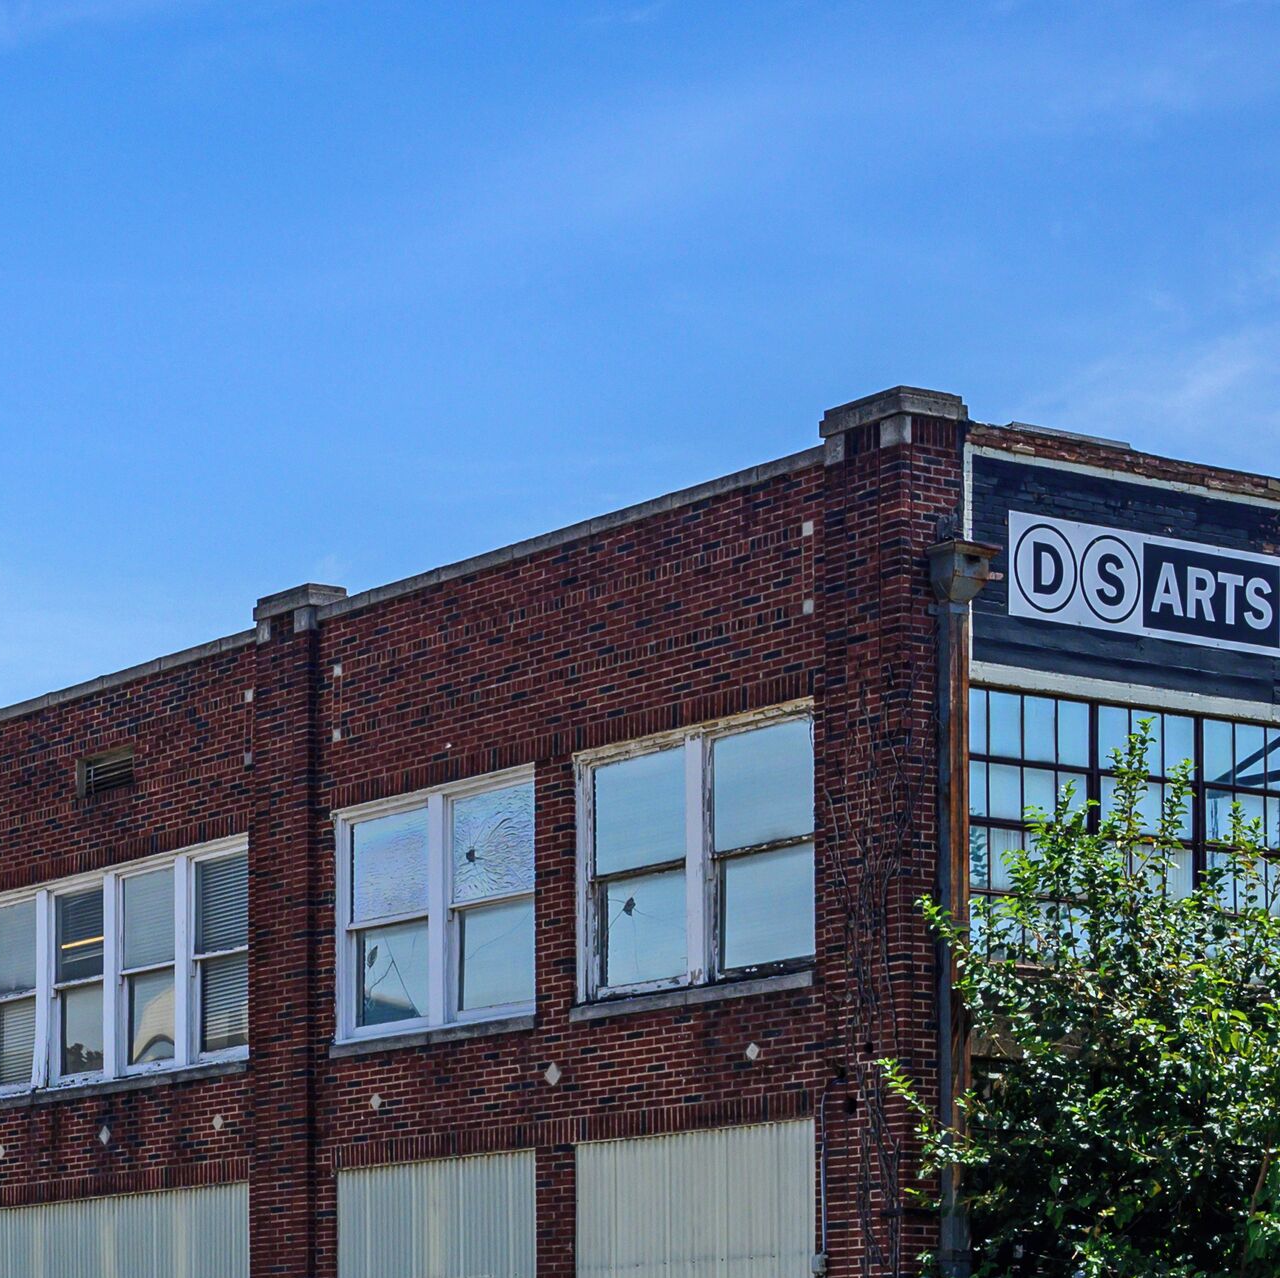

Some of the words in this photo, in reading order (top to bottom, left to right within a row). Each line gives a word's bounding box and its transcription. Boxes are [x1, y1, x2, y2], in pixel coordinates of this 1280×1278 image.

[1033, 541, 1064, 595] D
[1095, 553, 1125, 606] S
[1151, 562, 1273, 630] ARTS
